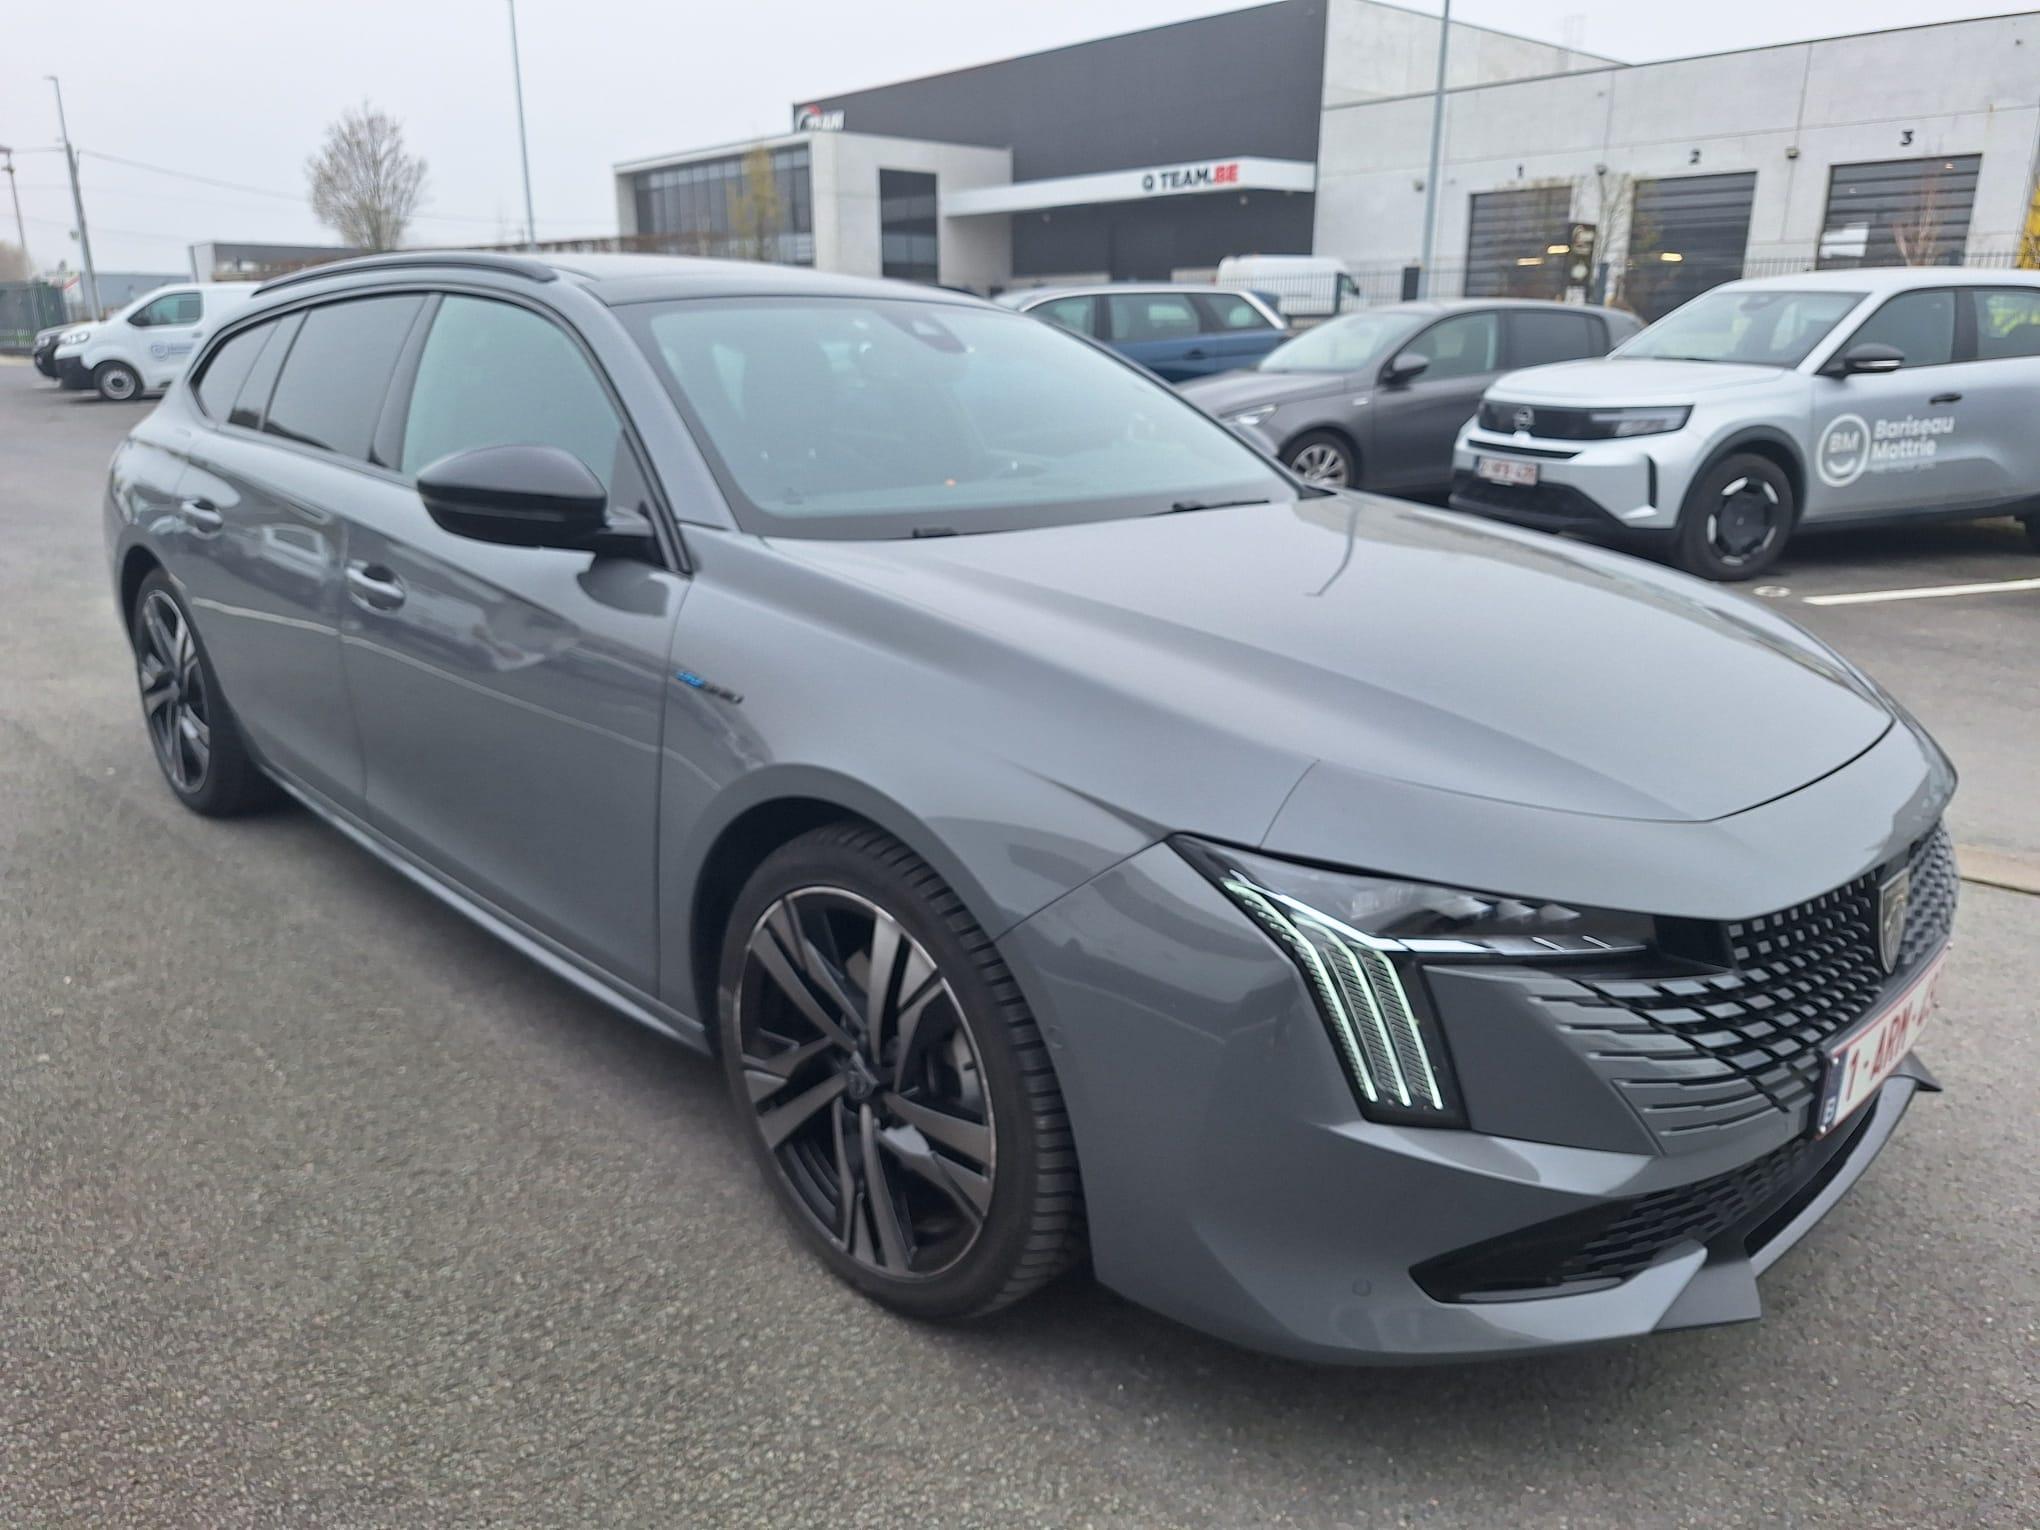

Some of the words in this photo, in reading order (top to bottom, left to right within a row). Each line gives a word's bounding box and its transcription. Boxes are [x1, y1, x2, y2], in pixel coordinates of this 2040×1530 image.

[1901, 129, 1914, 147] 3
[1690, 149, 1702, 165] 2
[1515, 163, 1525, 179] 1
[1142, 174, 1154, 192] Q
[1873, 414, 1956, 440] Bariseau
[1828, 430, 1861, 454] BM
[1871, 435, 1937, 460] Mottrie
